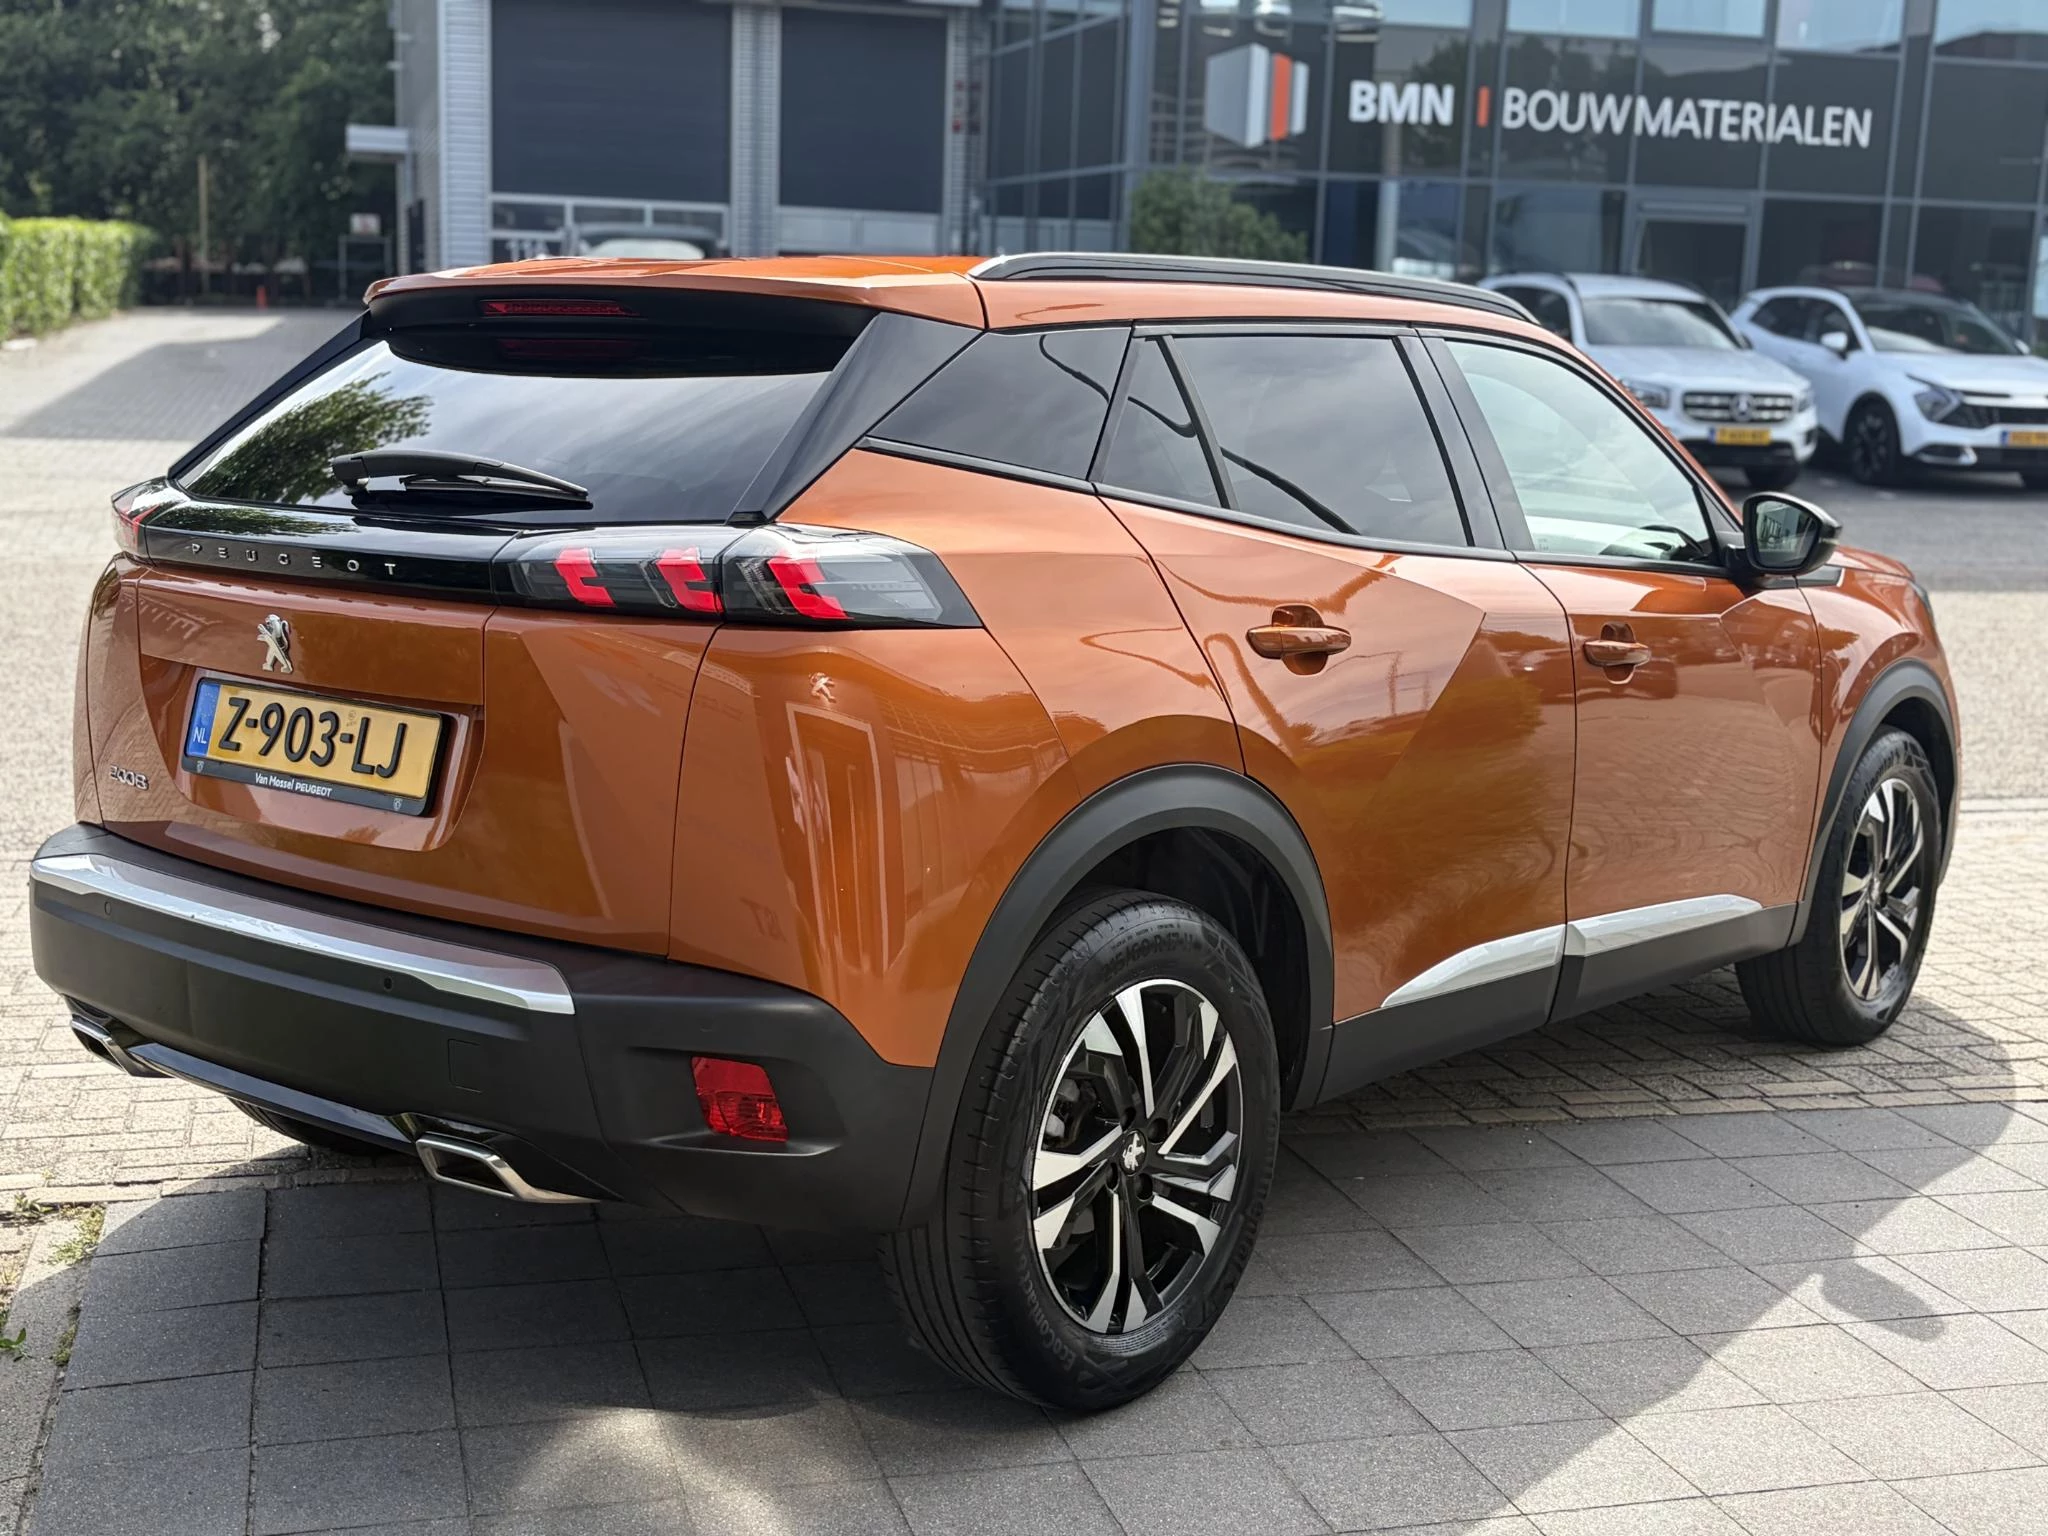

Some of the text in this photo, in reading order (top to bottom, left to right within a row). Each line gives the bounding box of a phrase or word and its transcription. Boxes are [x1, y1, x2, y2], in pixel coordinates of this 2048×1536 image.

[1349, 80, 1873, 148] BMN BOUWMATERIALEN
[191, 542, 397, 576] PEUGEOT
[193, 727, 207, 744] NL
[218, 696, 408, 779] Z-903-LJ
[255, 772, 332, 798] Van Mossel PEUGEOT
